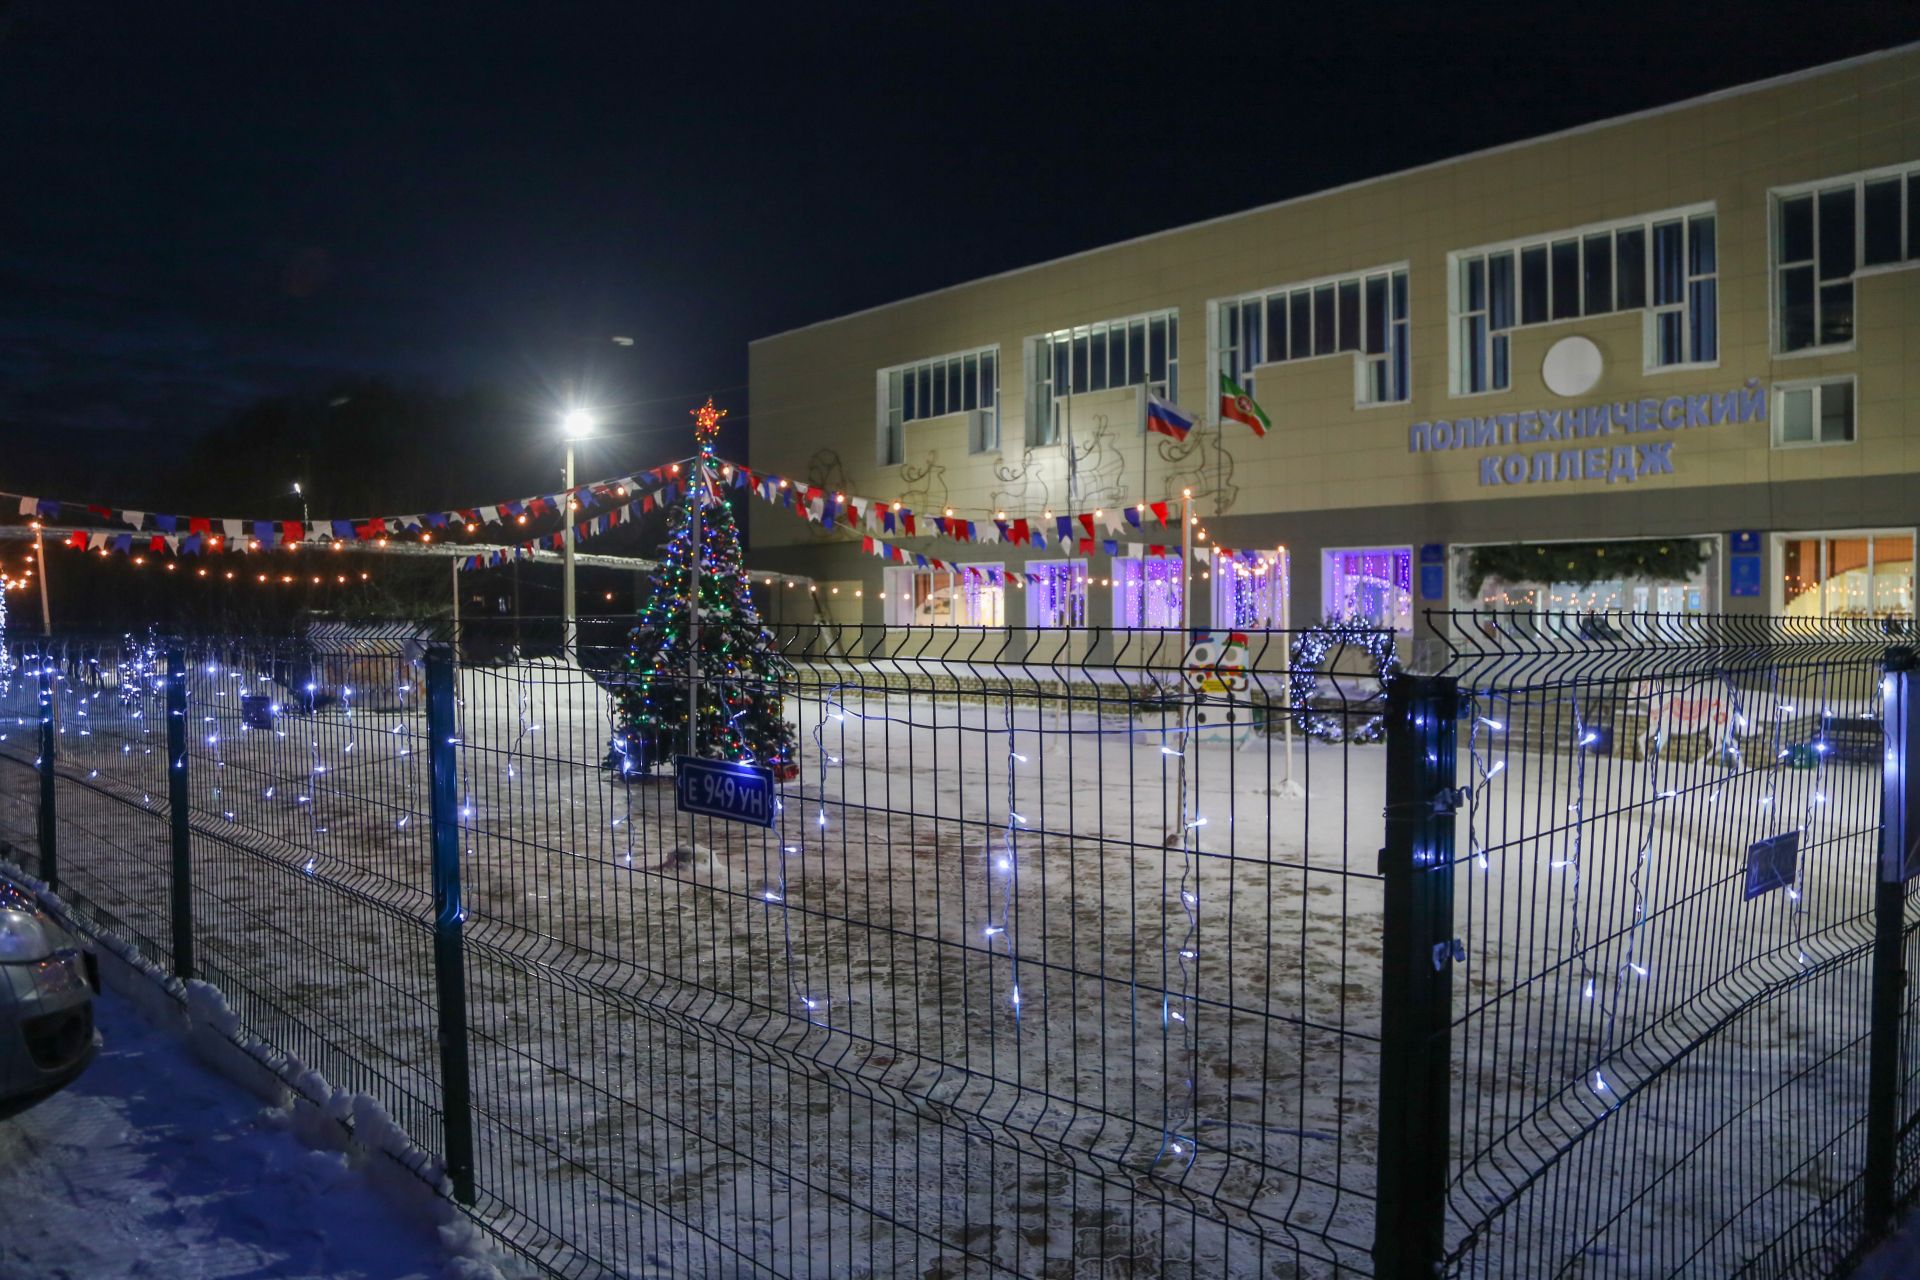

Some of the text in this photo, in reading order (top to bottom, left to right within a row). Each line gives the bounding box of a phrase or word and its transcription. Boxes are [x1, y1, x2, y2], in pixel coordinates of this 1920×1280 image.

[1409, 377, 1767, 453] ПОЛИТЕХНИЧЕСКИЙ
[1479, 441, 1675, 486] КОЛЛЕДЖ
[704, 774, 735, 808] 949
